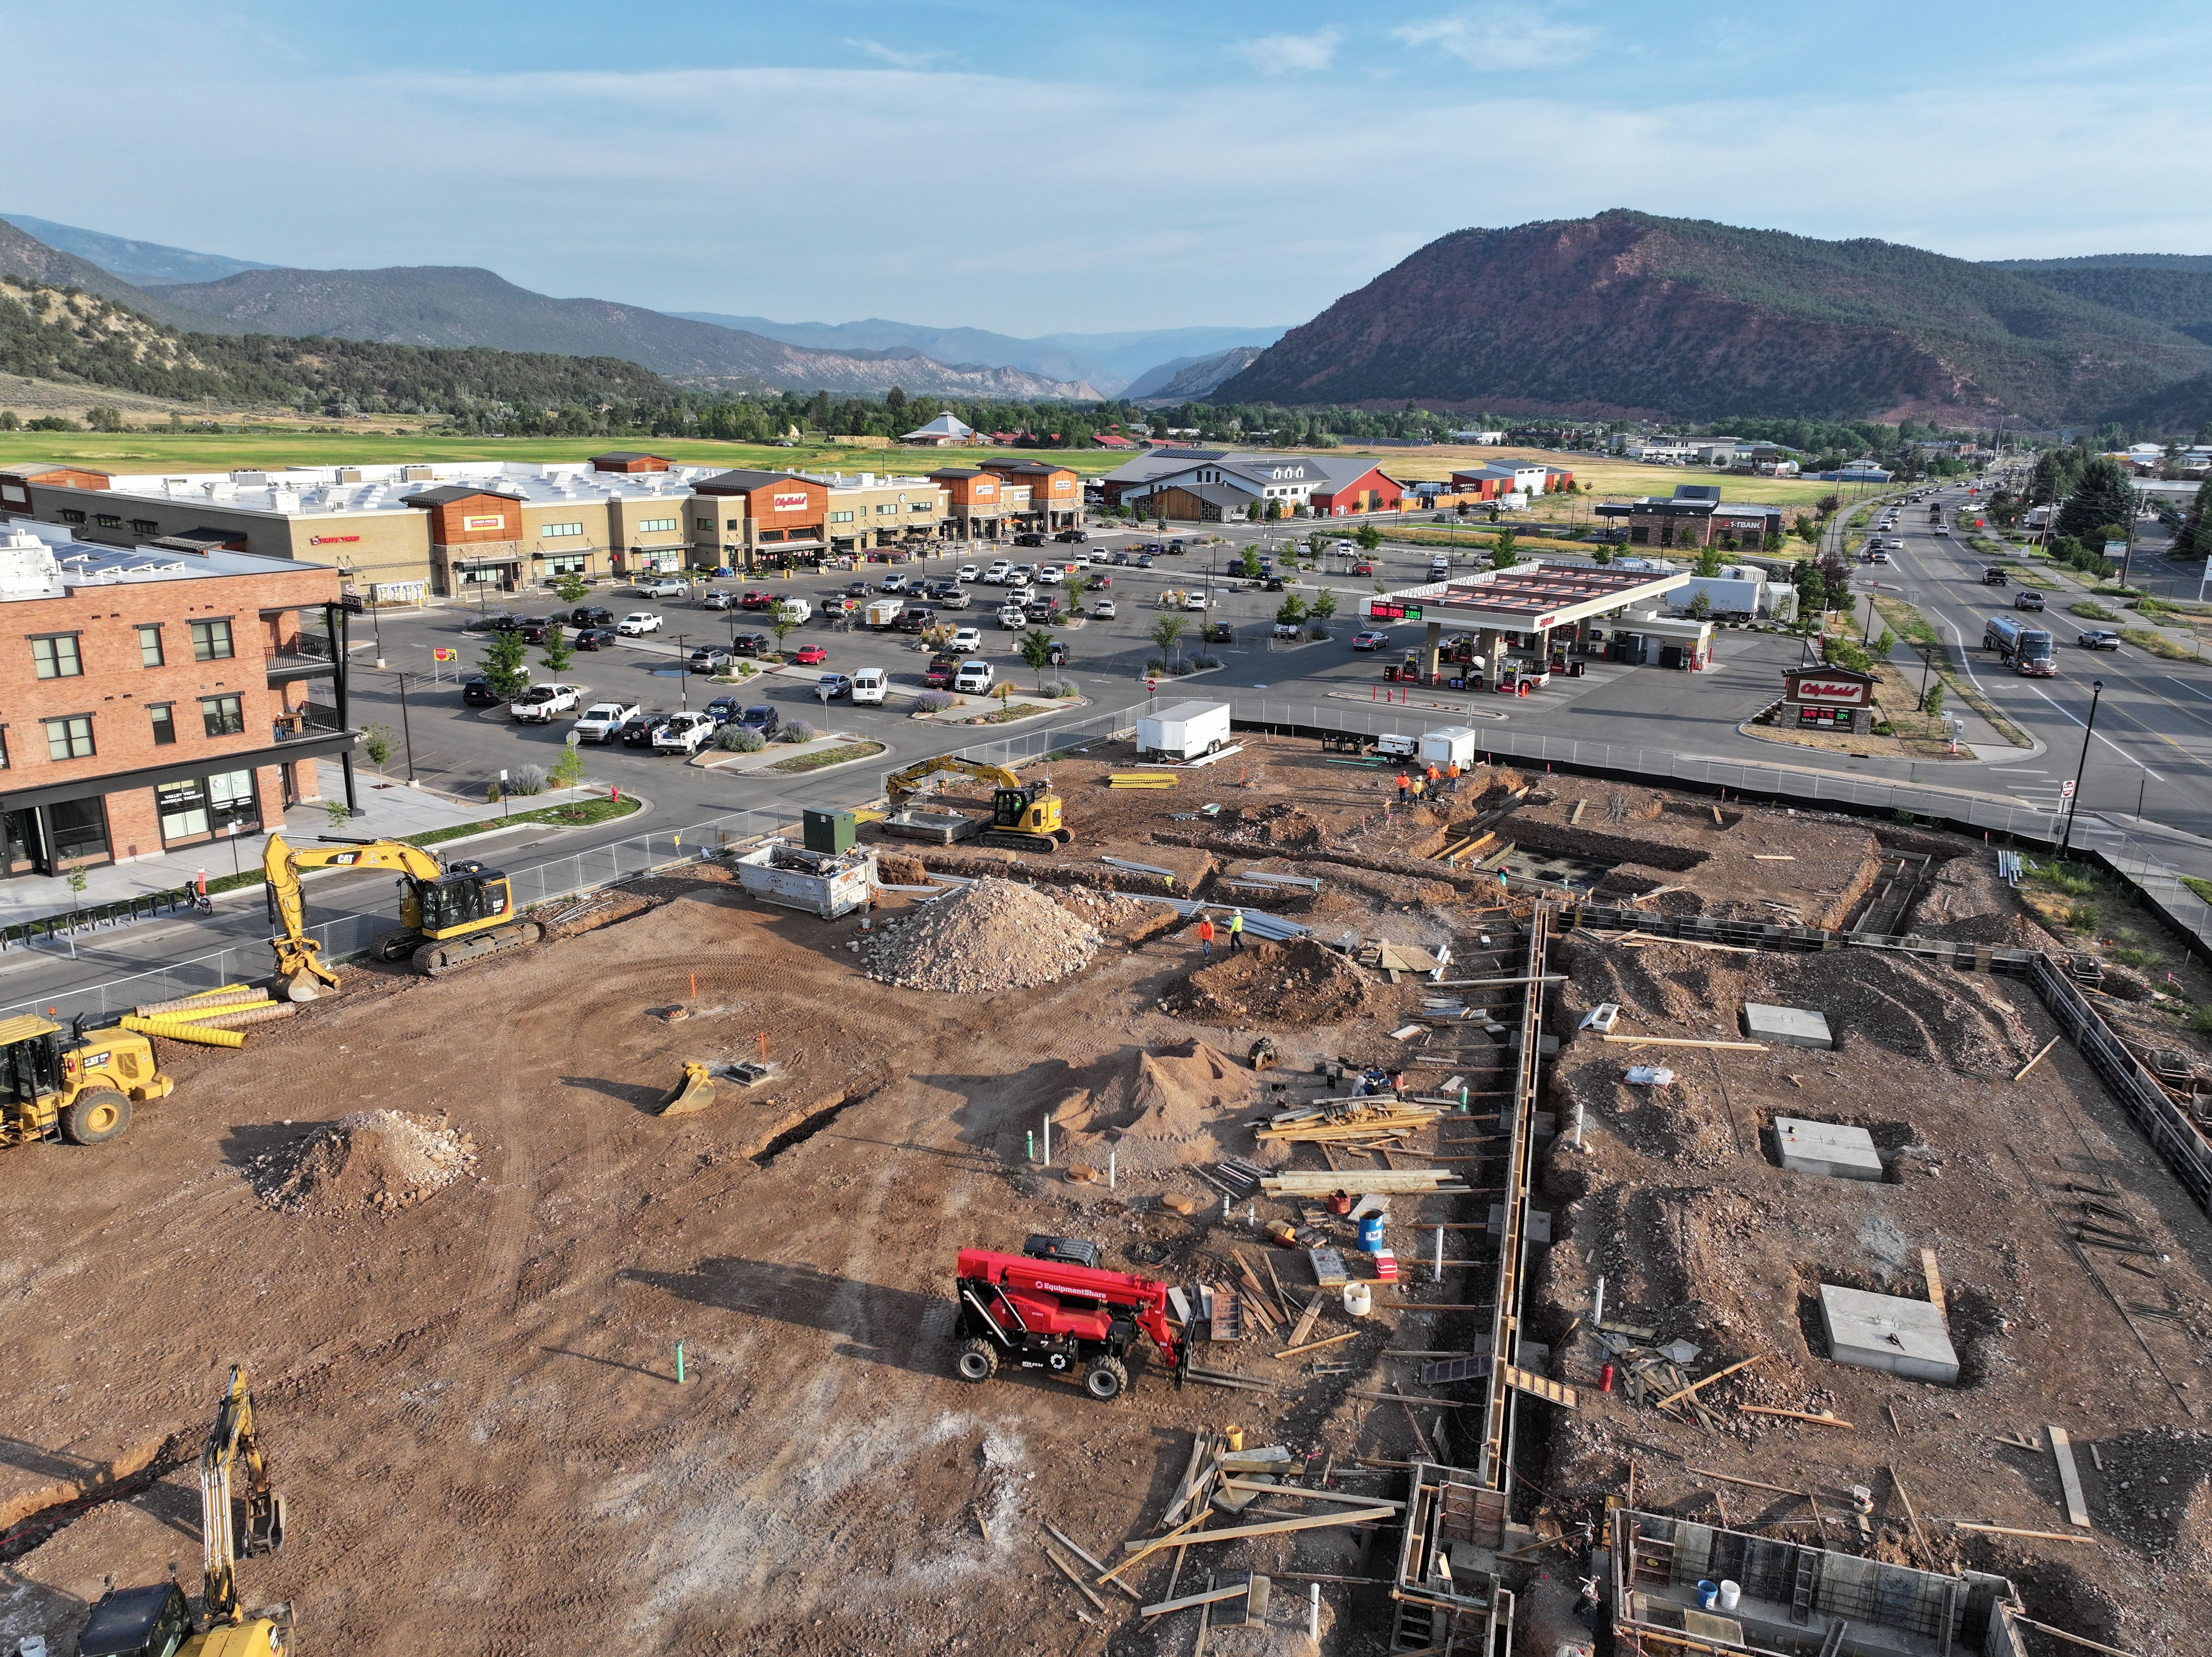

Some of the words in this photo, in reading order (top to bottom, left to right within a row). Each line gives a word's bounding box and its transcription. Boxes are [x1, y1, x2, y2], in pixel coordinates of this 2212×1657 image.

[775, 498, 788, 508] City
[342, 596, 360, 606] 2001
[1801, 683, 1822, 697] City
[1821, 684, 1860, 697] Market
[337, 854, 354, 864] CAT
[493, 899, 504, 908] CAT
[84, 1056, 99, 1067] CAT
[1044, 1282, 1106, 1298] EquipmentShare
